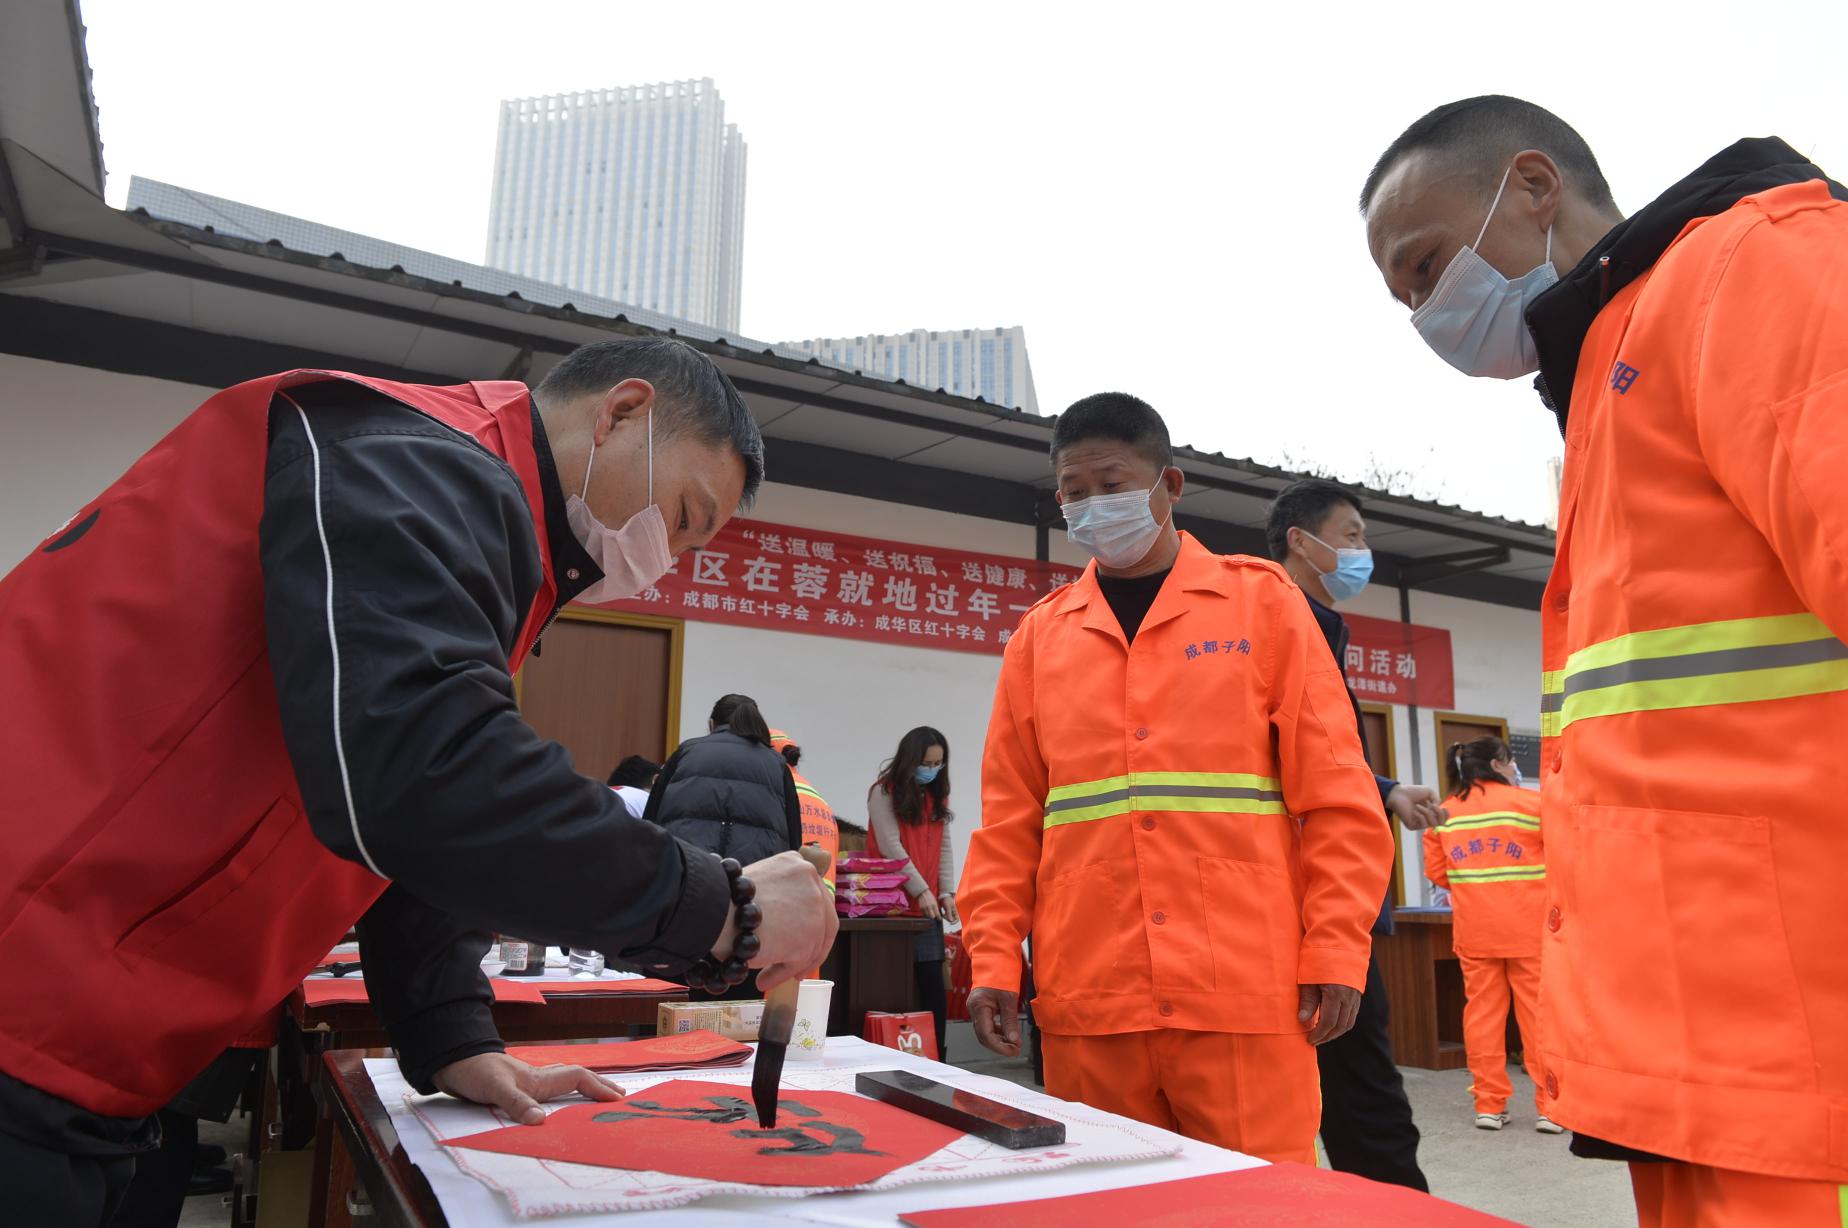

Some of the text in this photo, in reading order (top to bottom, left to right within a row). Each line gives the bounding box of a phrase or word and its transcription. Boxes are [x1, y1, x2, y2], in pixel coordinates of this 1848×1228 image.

[743, 530, 1080, 592] “送温暖、送祝福、送健康、送
[1184, 638, 1252, 660] 成都子阳
[1344, 644, 1416, 679] 问活动
[1450, 837, 1524, 863] 成都子阳
